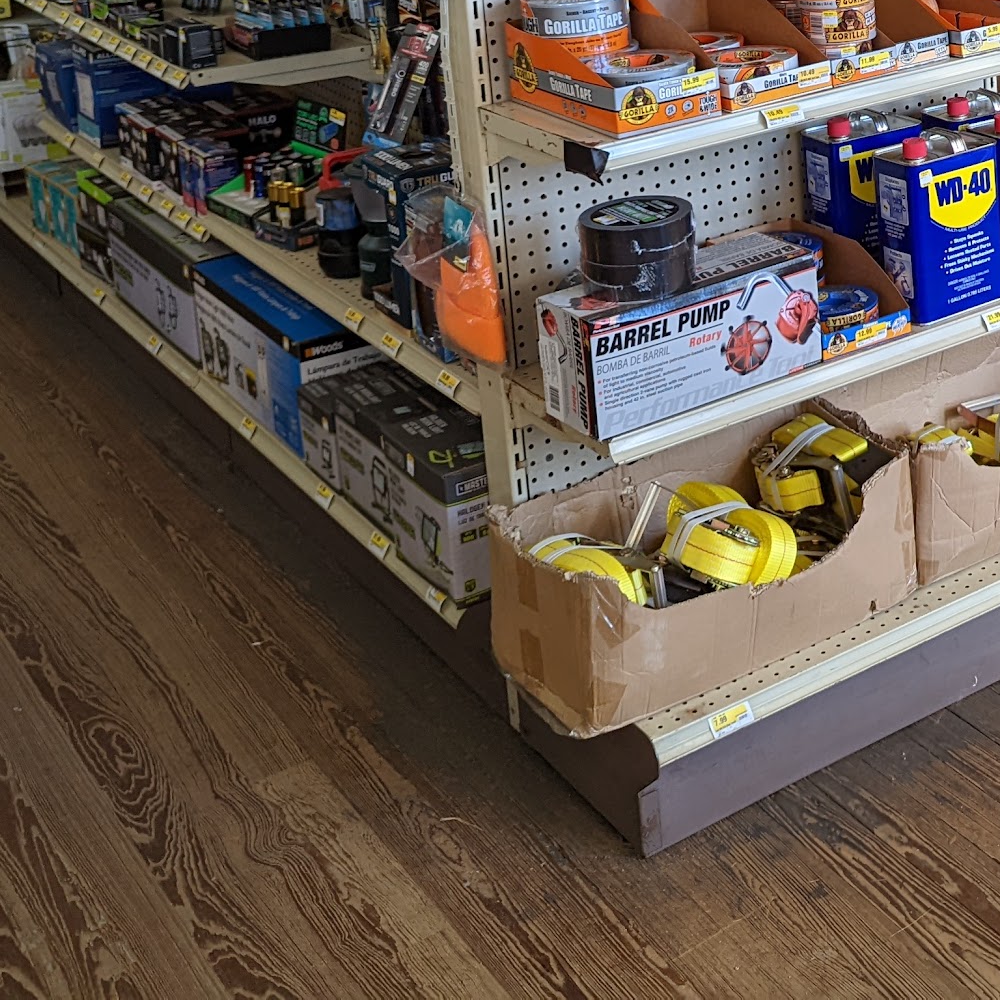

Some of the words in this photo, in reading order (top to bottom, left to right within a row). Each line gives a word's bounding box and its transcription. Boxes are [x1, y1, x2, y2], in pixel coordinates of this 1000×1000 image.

[544, 18, 597, 35] GORILLA
[597, 11, 623, 30] TAPE
[832, 31, 865, 41] GORILLA
[918, 41, 936, 50] GORILLA
[936, 37, 948, 46] TAPE
[800, 69, 815, 77] 10.49
[684, 77, 699, 86] 15.99
[764, 77, 788, 89] GORILLA
[549, 77, 576, 97] GORILLA
[575, 84, 592, 102] TAPE
[700, 95, 717, 106] TOUGH
[624, 104, 656, 118] GORILLA
[248, 114, 277, 127] HALO
[935, 167, 991, 207] WD-40
[727, 244, 797, 270] BARREL
[828, 311, 865, 325] GORILLA
[595, 318, 672, 357] BARREL
[677, 299, 731, 333] PUMP
[689, 330, 722, 348] Rotary
[313, 340, 344, 357] Woods
[570, 316, 585, 378] BARREL
[343, 359, 351, 368] de
[597, 356, 629, 376] BOMBA
[630, 353, 641, 365] DE
[642, 345, 671, 362] BARRIL
[577, 380, 589, 430] PUMP
[603, 361, 764, 434] Performance
[714, 715, 728, 726] 7.99
